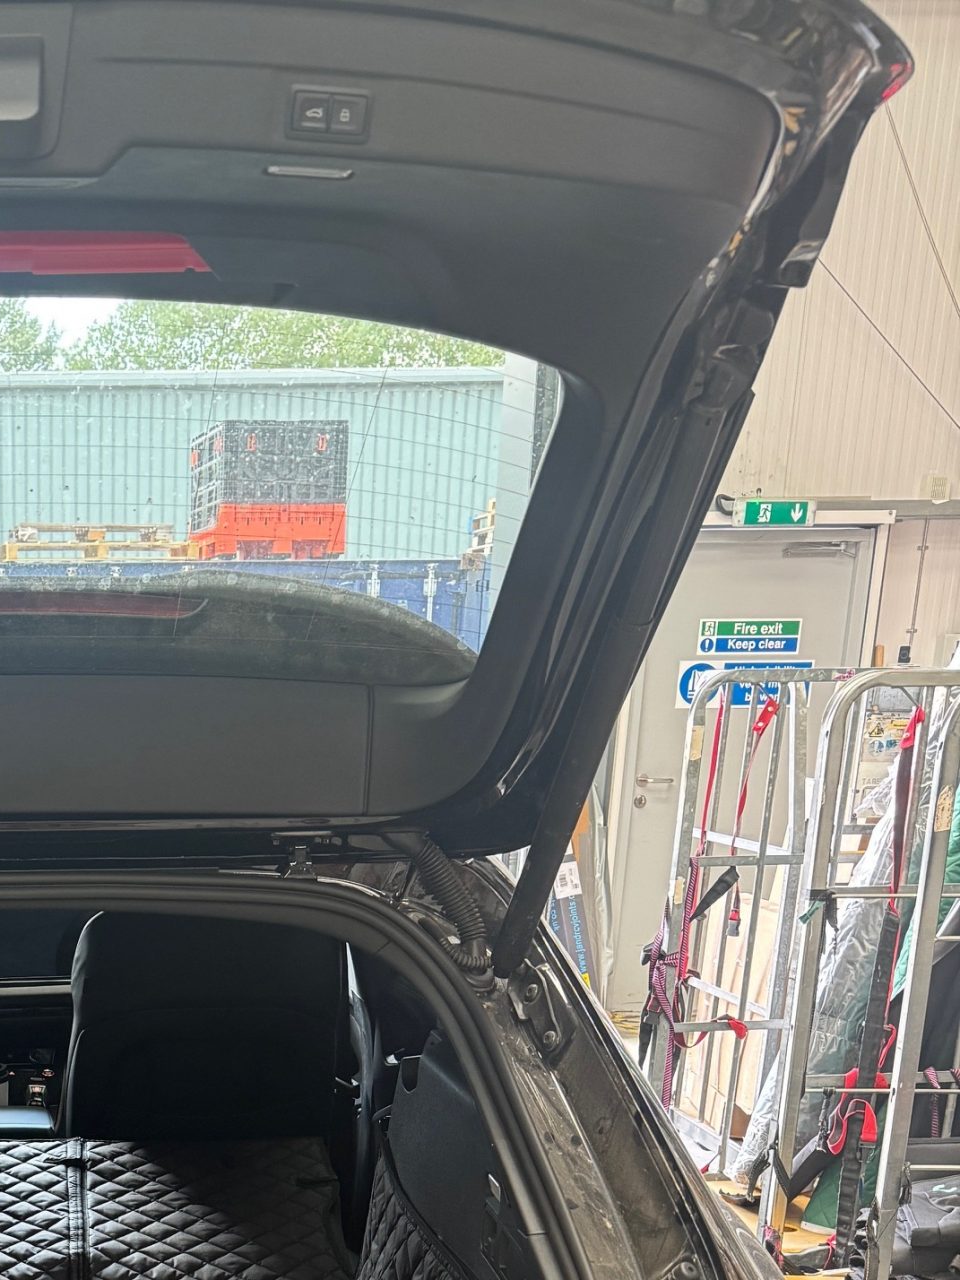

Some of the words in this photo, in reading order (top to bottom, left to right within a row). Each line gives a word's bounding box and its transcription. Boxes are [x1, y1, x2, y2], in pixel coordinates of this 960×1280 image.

[734, 622, 757, 634] Fire
[760, 622, 783, 634] exit
[727, 639, 756, 651] Keep
[758, 639, 786, 649] clear
